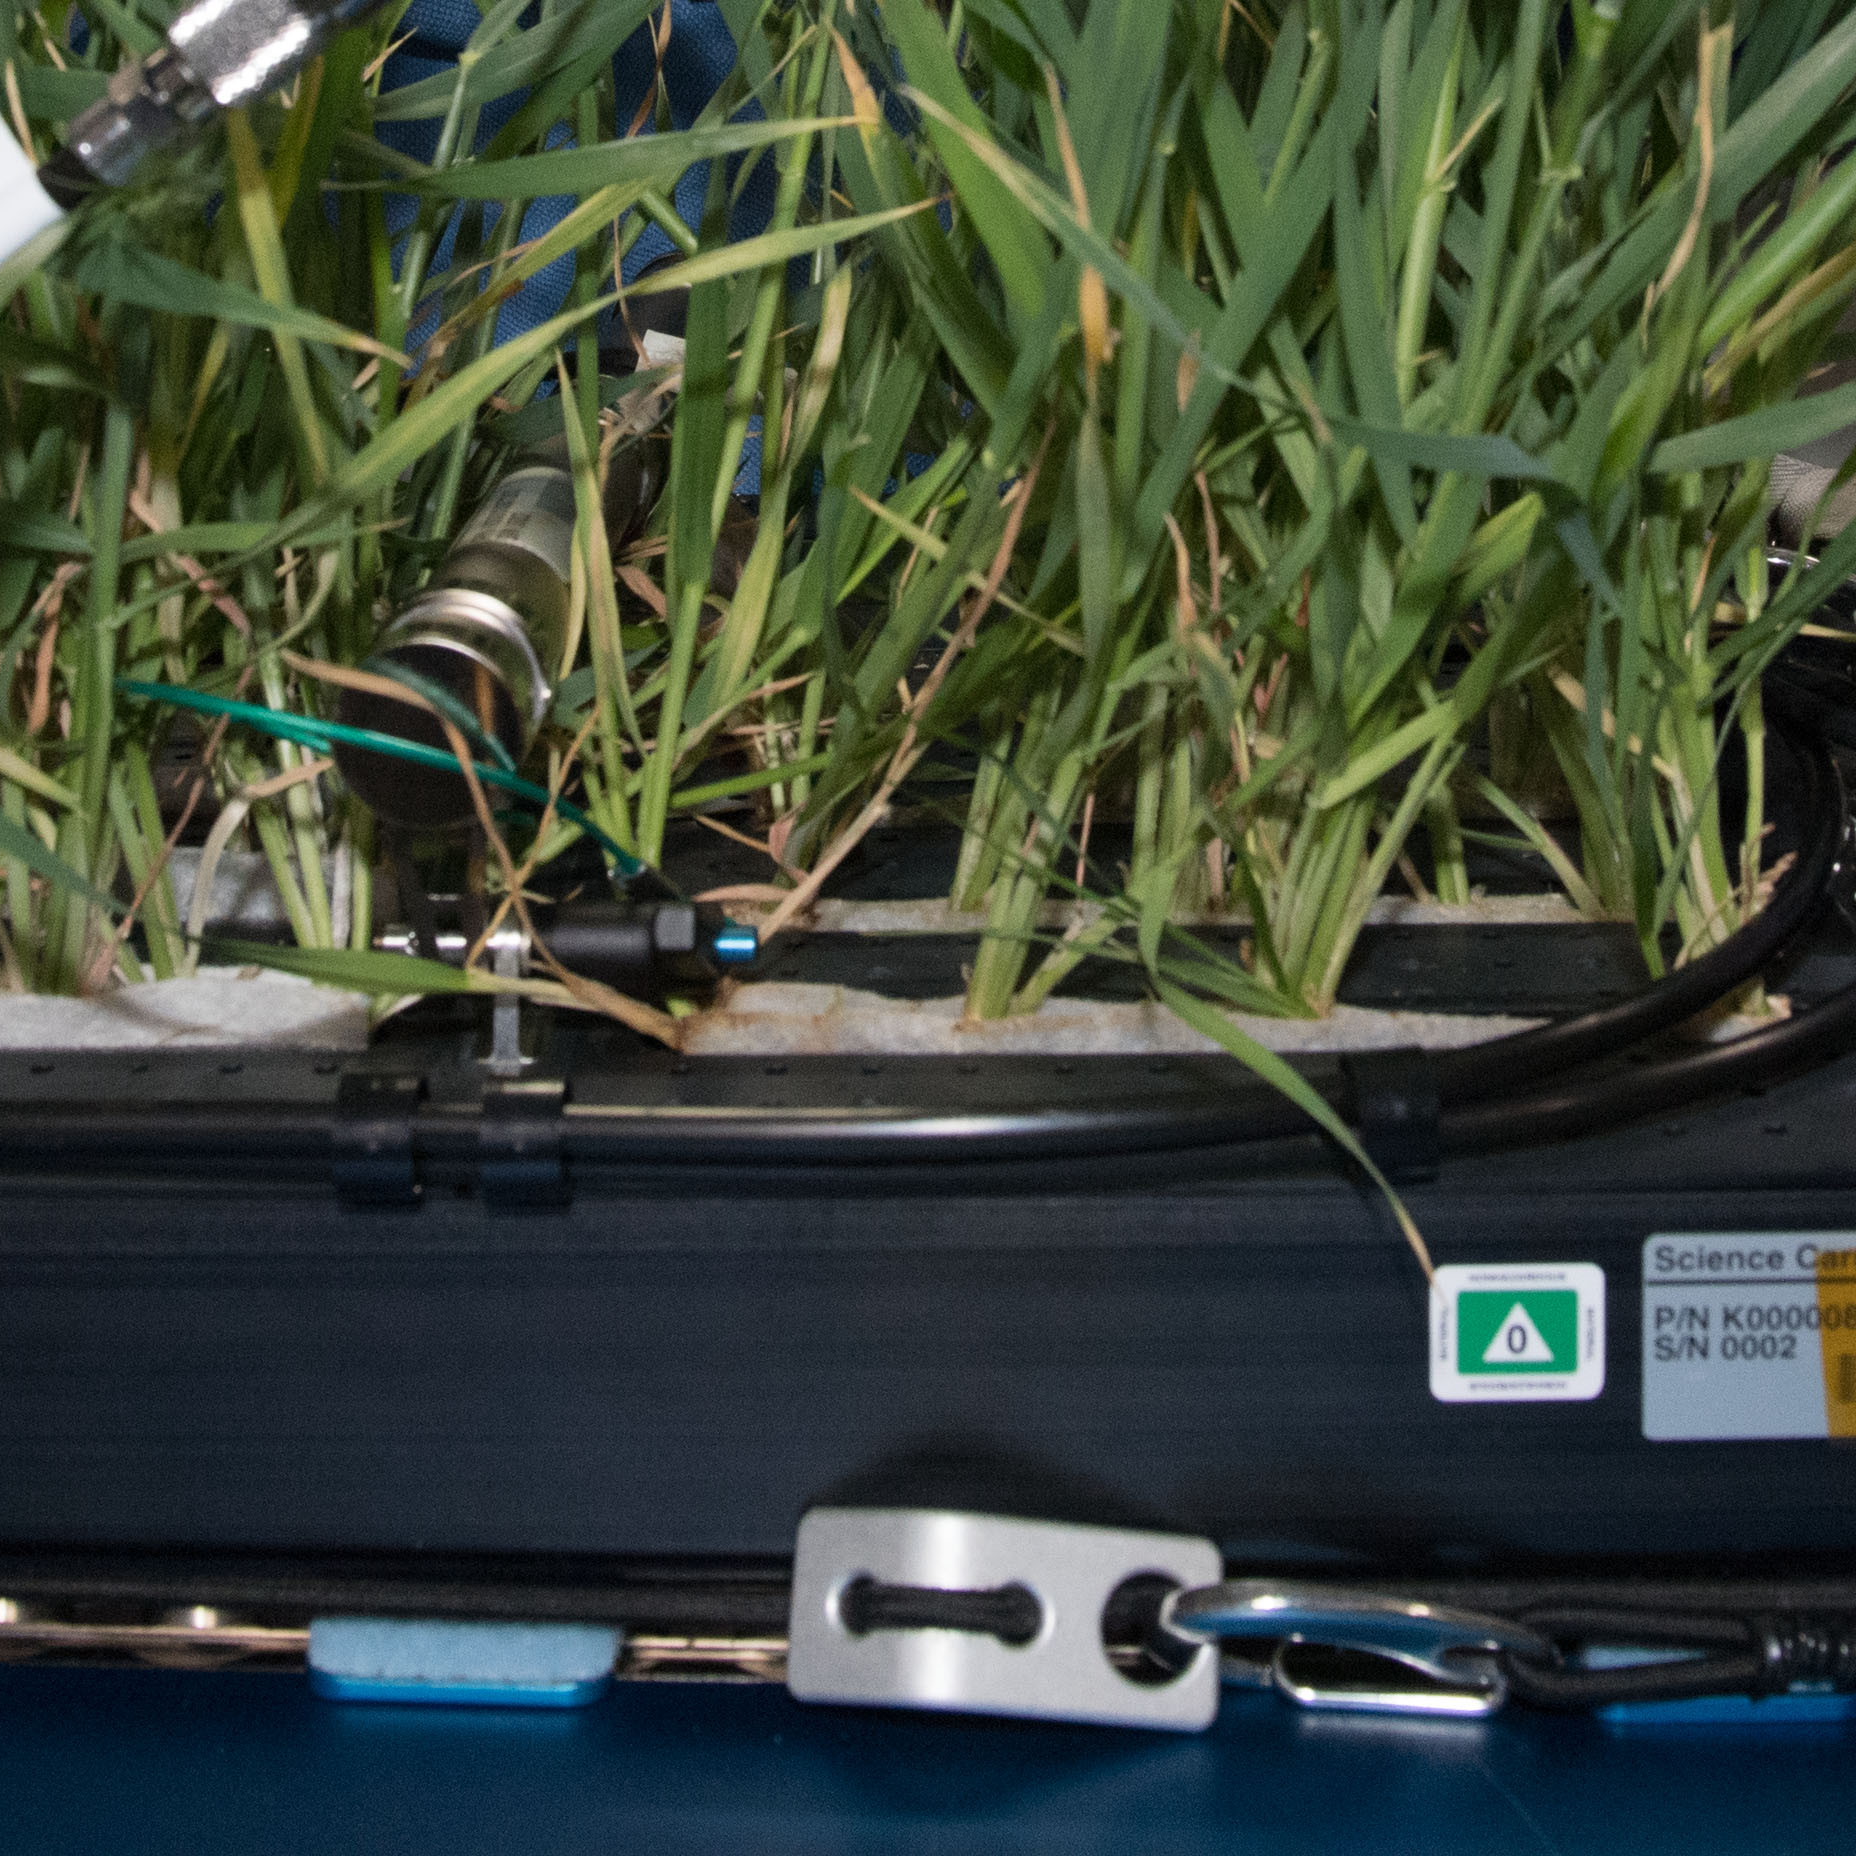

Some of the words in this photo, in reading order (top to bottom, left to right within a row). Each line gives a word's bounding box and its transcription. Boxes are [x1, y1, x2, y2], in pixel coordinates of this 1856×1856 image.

[1655, 1245, 1784, 1272] Science
[1654, 1305, 1710, 1332] P/N
[1507, 1324, 1527, 1354] 0
[1654, 1335, 1709, 1362] S/N
[1720, 1335, 1797, 1361] 0002
